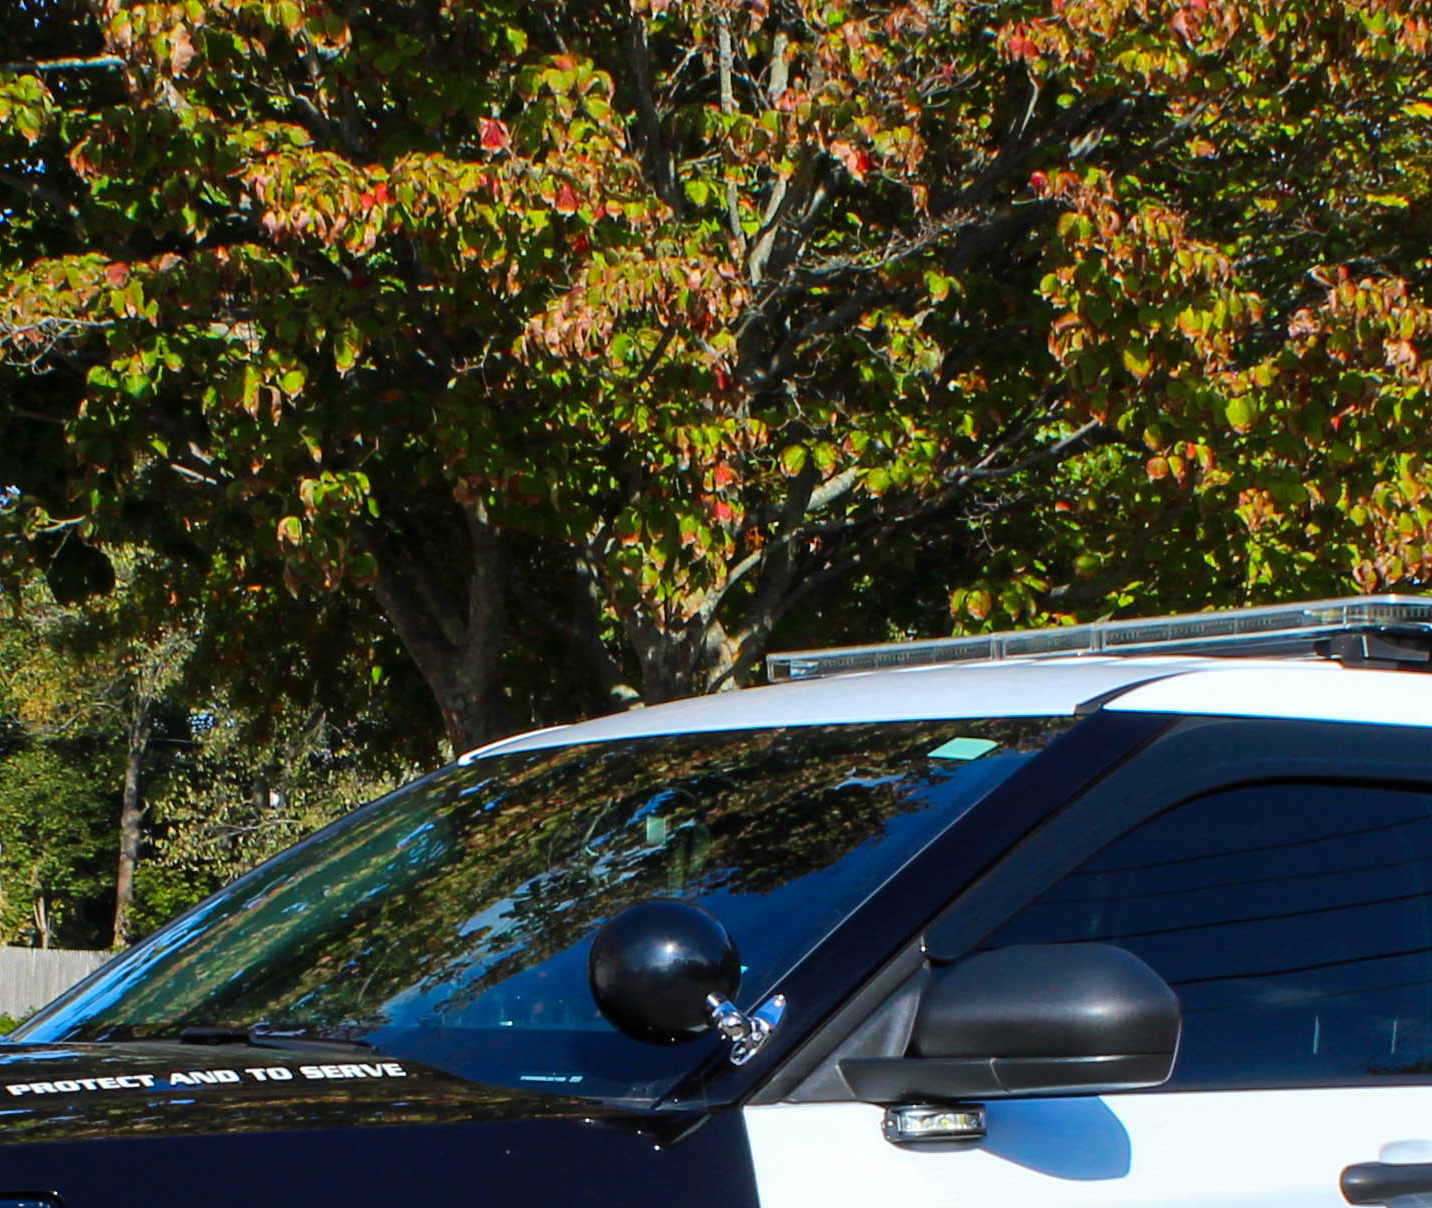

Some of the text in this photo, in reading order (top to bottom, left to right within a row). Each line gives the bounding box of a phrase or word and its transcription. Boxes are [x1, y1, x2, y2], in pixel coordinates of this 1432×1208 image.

[5, 1073, 155, 1097] PROTECT
[169, 1068, 241, 1086] AND
[243, 1065, 293, 1082] TO
[300, 1062, 408, 1080] SERVE
